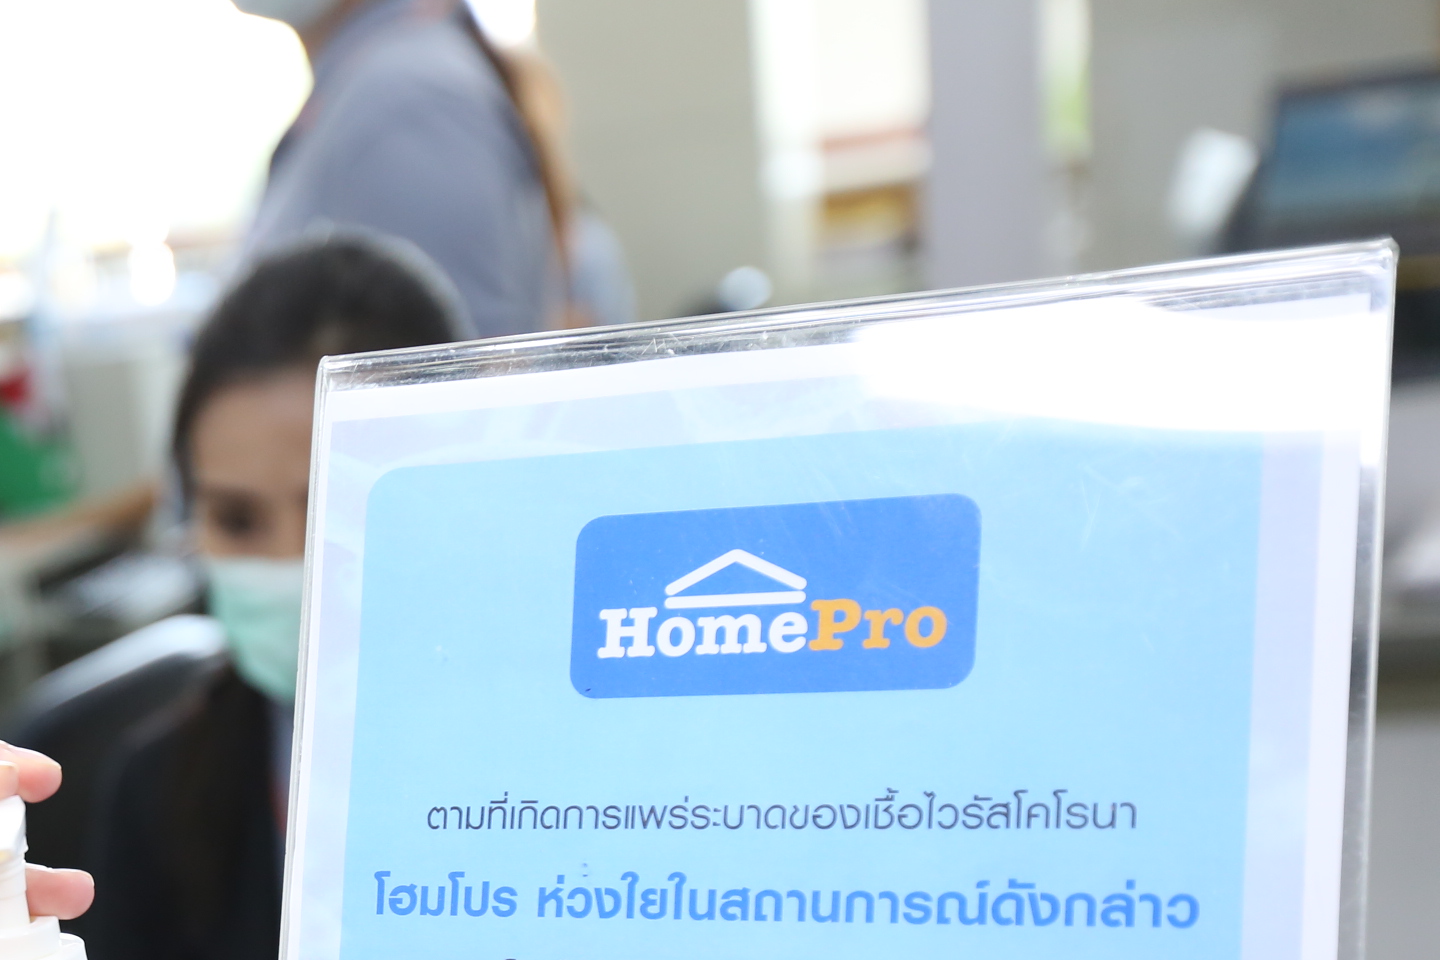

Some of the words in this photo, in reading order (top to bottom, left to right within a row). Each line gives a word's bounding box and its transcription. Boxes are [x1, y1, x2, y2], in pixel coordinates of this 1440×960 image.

[597, 598, 948, 659] HomePro
[426, 787, 1138, 831] ตามที่เกิดการแพร่ระบาดของเชื้อไวรัสโคโรนา
[373, 870, 519, 918] โฮมโปร
[536, 870, 1201, 930] ห่วงใยในสถานการณ์ดังกล่าว
